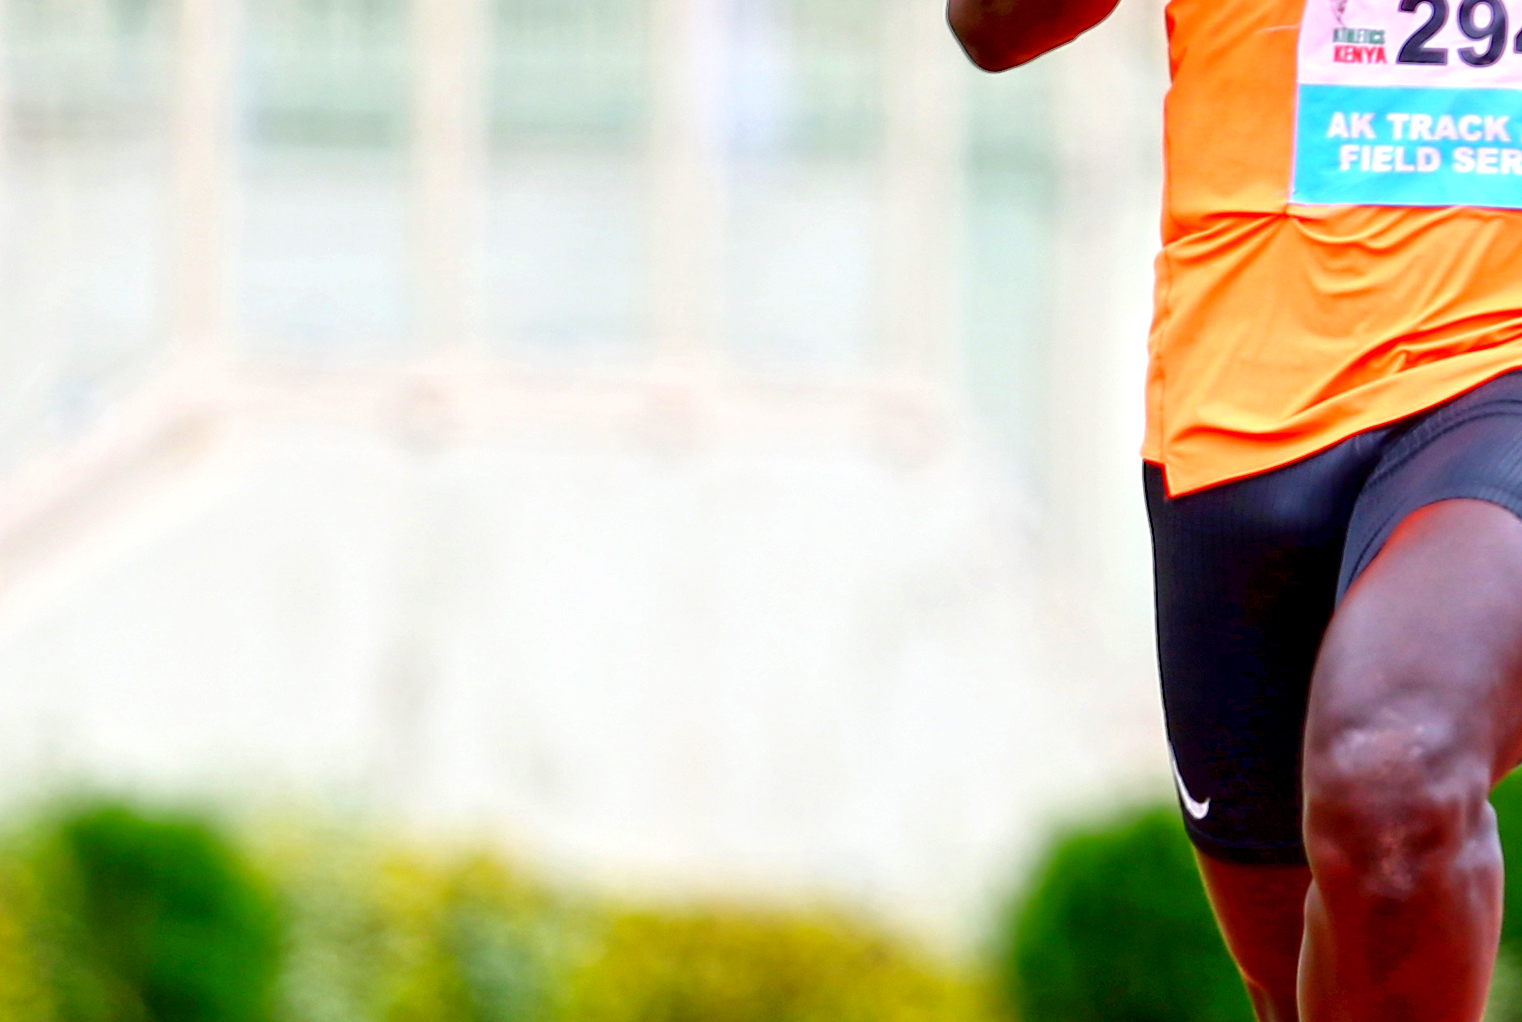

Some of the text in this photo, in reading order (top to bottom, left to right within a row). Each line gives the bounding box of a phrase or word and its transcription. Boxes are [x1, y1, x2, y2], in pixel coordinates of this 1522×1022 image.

[1333, 45, 1387, 64] KENYA
[1326, 111, 1376, 139] AK
[1386, 113, 1511, 142] TRACK
[1339, 144, 1442, 173] FIELD
